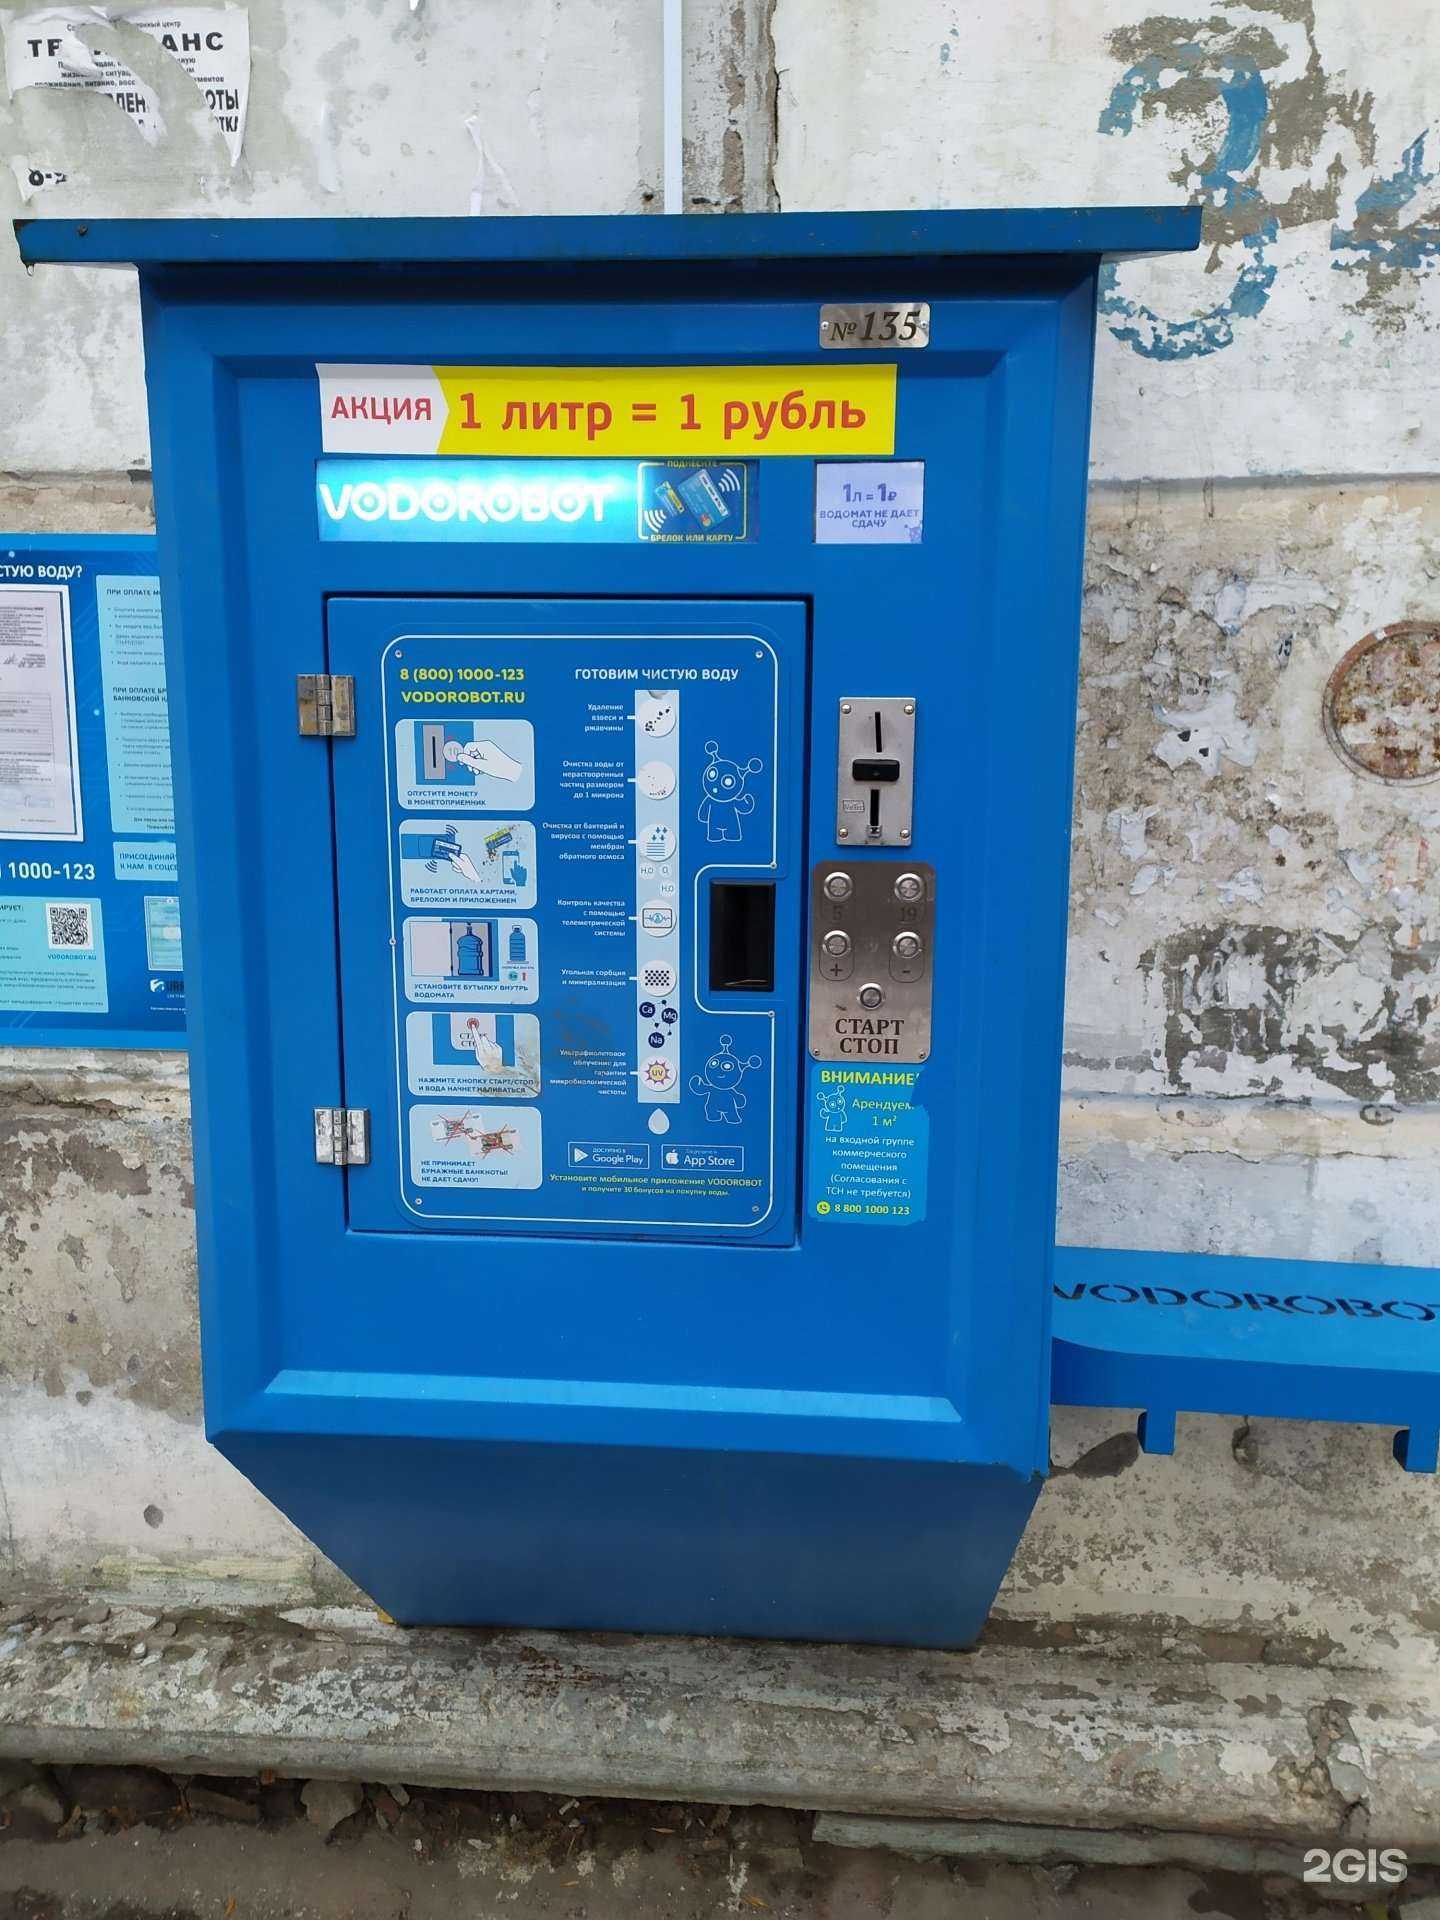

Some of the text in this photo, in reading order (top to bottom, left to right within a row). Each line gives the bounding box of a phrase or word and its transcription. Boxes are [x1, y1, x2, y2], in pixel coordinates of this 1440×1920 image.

[331, 389, 866, 440] АКЦИЯ 1 литр = 1 рубль
[319, 483, 613, 522] VODOROBOT
[820, 509, 920, 519] ВОДОМАТ НЕ ДАЕТ
[852, 519, 887, 528] СДАЧУ
[38, 565, 82, 580] ВОДУ?
[400, 668, 524, 683] 8 (800) 1000-123
[575, 669, 739, 681] ГОТОВИМ ЧИСТУЮ ВОДУ
[401, 691, 525, 703] VODOROBOT.RU
[588, 703, 624, 712] Удаление
[585, 725, 624, 733] ржавчины
[562, 760, 593, 768] Очистка
[586, 782, 624, 790] размером
[543, 822, 572, 830] Очистка
[584, 822, 617, 830] бактерий
[551, 833, 580, 841] вирусов
[587, 833, 624, 841] помощью
[120, 853, 176, 861] ПРИСОЕДИНЯЙ
[559, 853, 597, 861] обратного
[9, 862, 95, 881] 1000-123
[557, 899, 592, 907] Контроль
[561, 968, 626, 977] Угольная сорбция
[414, 983, 461, 991] УСТАНОВИТЕ
[641, 1006, 653, 1014] Ca
[663, 1011, 677, 1021] Mg
[835, 1018, 905, 1036] СТАРТ
[650, 1036, 663, 1044] Na
[840, 1037, 900, 1054] СТОП
[560, 1049, 626, 1057] Ультрафиолетовое
[489, 1078, 534, 1086] СТАРТ/СТОП
[550, 1078, 627, 1086] микробиологической
[872, 1116, 878, 1126] 1
[840, 1135, 880, 1145] входной
[882, 1138, 915, 1147] группе
[832, 1149, 907, 1159] коммерческого
[593, 1154, 644, 1165] Google Play
[684, 1156, 735, 1166] App Store
[841, 1163, 898, 1172] помещения
[550, 1173, 762, 1187] Установите мобильное приложение VODOROBOT
[830, 1174, 900, 1185] (Согласования
[588, 1186, 622, 1194] получите
[634, 1186, 664, 1194] бонусов
[677, 1189, 707, 1197] покупку
[826, 1186, 844, 1195] ТСН
[860, 1188, 911, 1198] требуется)
[834, 1203, 910, 1215] 8 800 1000 123
